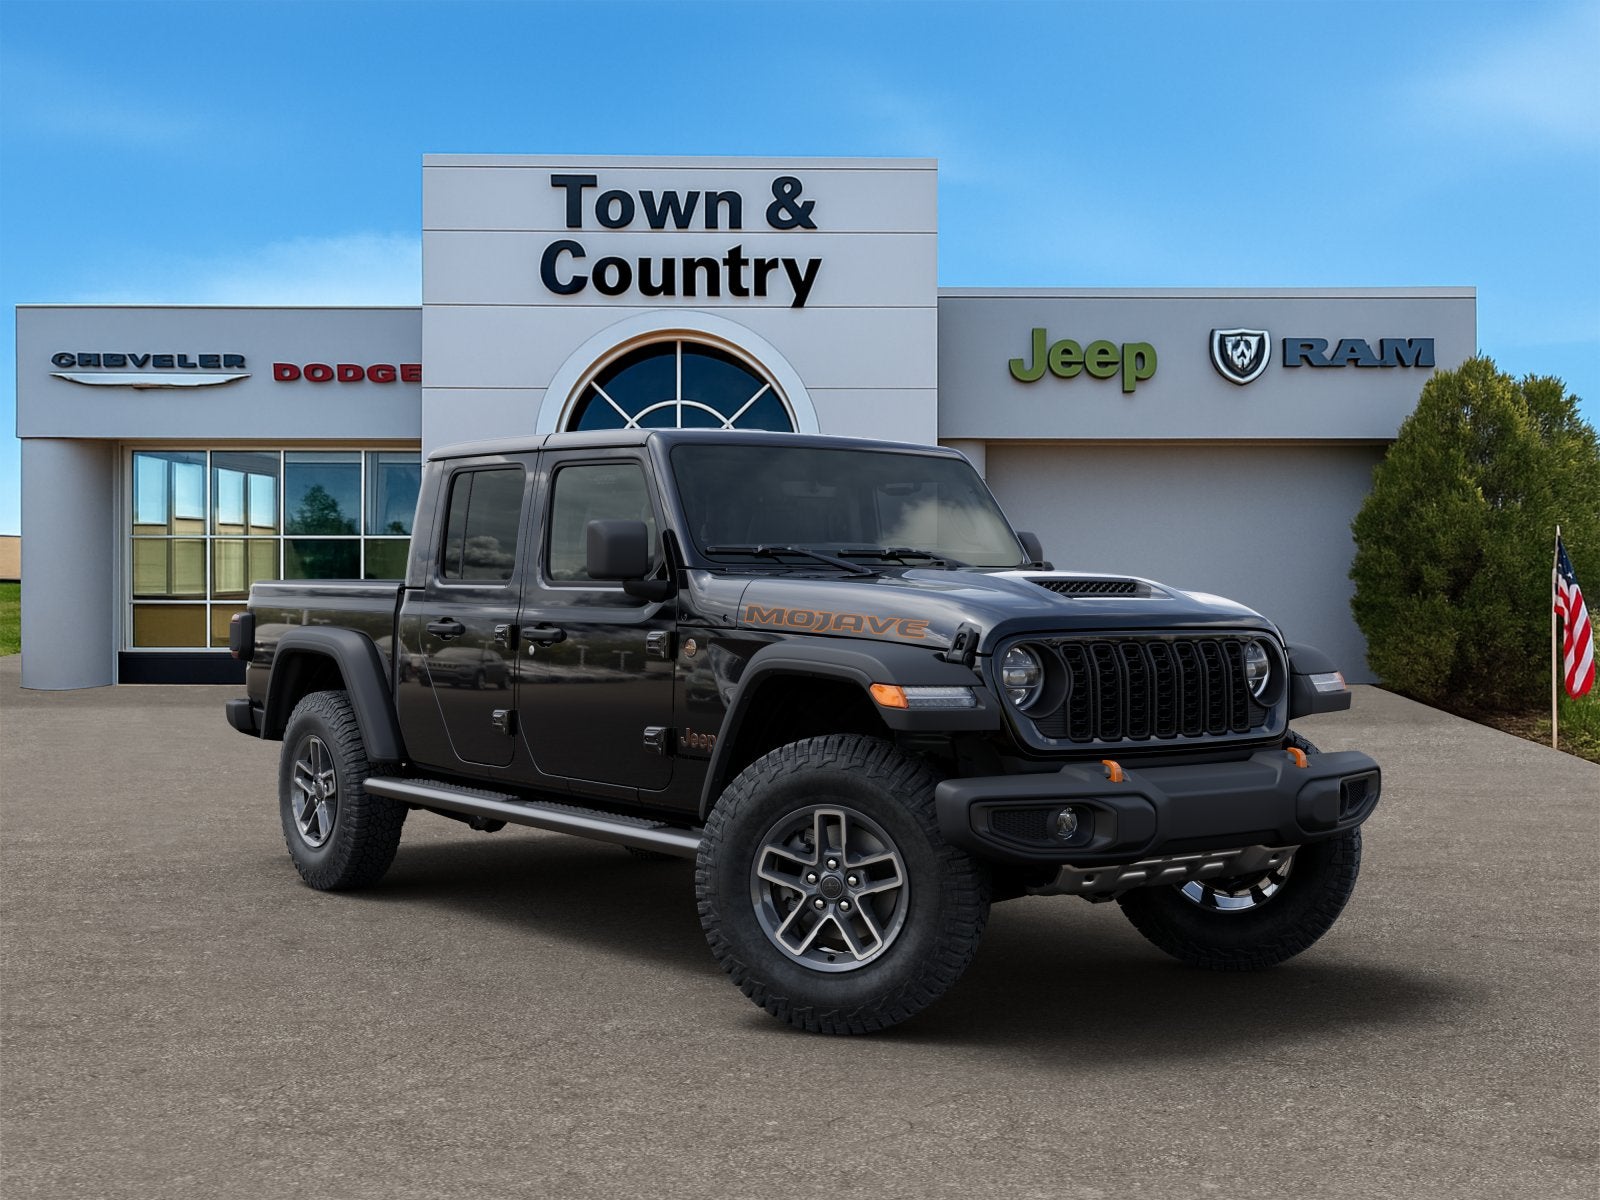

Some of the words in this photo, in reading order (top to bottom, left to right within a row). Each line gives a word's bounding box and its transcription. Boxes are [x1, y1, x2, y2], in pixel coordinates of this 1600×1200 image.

[550, 174, 743, 229] Town
[765, 176, 818, 230] &
[540, 239, 823, 308] Country
[1009, 328, 1157, 393] Jeep
[1282, 337, 1436, 368] RAM
[273, 362, 422, 384] DODGE
[744, 605, 930, 639] MOJAVE
[680, 727, 718, 753] Jeep
